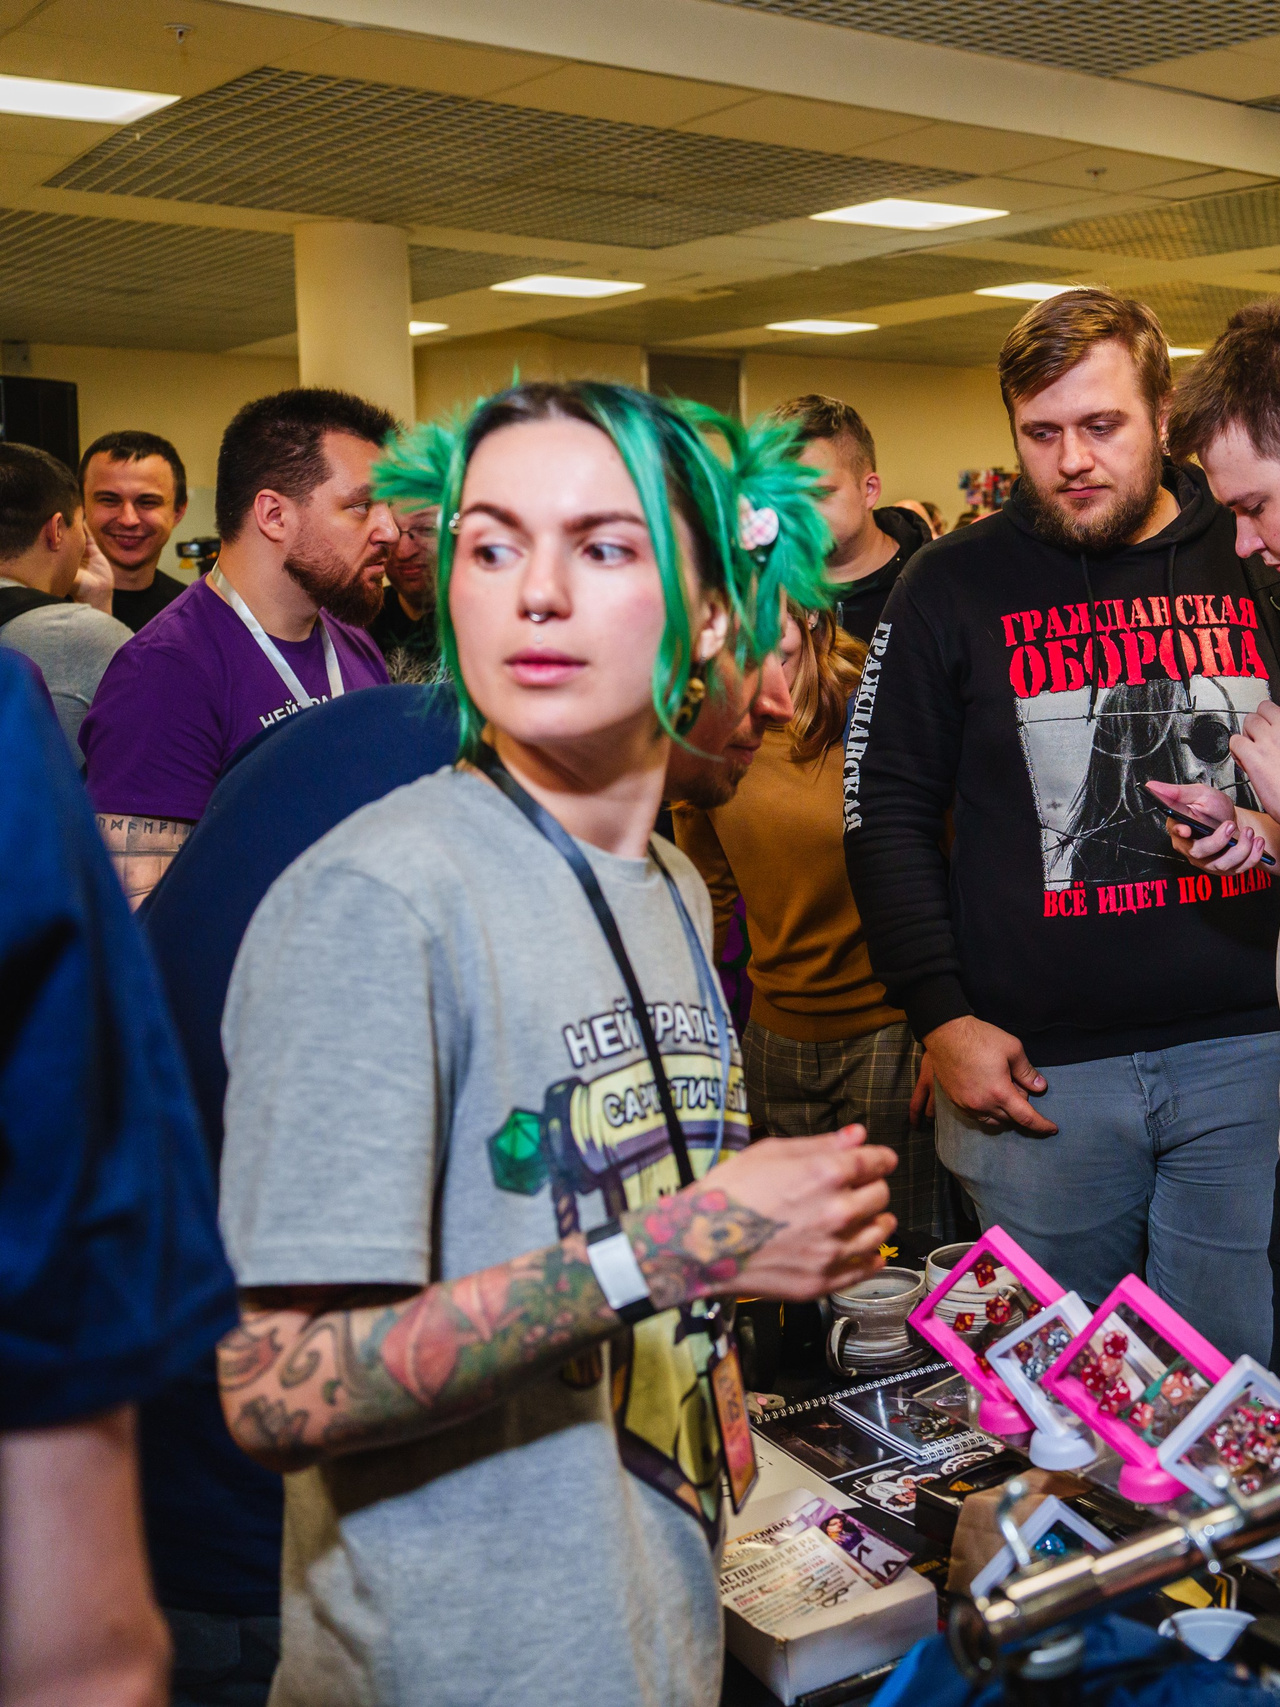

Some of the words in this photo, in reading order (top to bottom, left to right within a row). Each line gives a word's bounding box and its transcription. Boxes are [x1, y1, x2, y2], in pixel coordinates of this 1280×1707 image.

[1001, 594, 1258, 647] ГРАЖДАНСКАЯ
[1009, 627, 1270, 698] ОБОРОНА
[1043, 881, 1088, 917] ВСЁ
[1097, 879, 1168, 916] ИДЕТ
[1177, 875, 1212, 904] ПО
[719, 1551, 785, 1587] АСТОЛЬНАЯ
